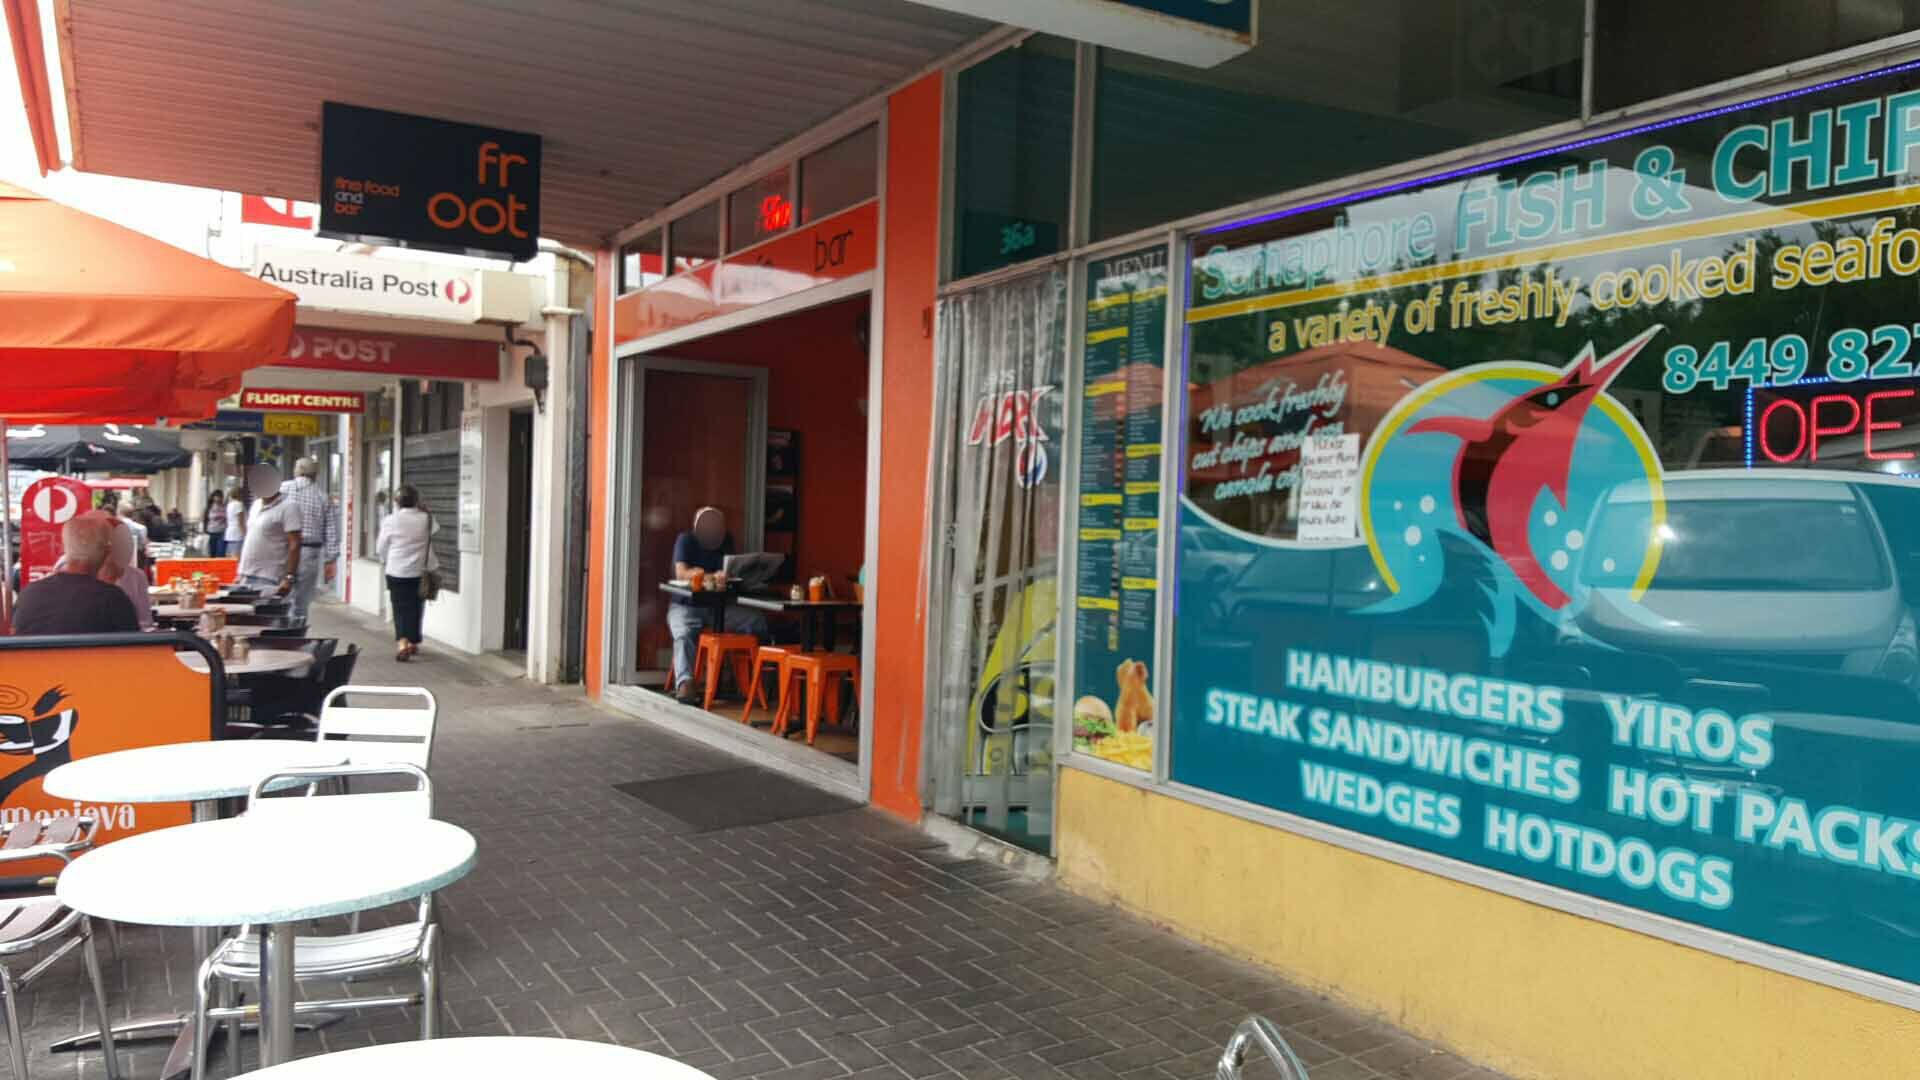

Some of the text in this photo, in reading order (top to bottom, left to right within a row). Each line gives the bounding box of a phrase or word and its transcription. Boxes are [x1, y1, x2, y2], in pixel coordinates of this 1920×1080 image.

[365, 179, 399, 198] food
[478, 141, 528, 188] fr
[1455, 159, 1608, 252] FISH
[1632, 145, 1693, 221] &
[1712, 89, 1920, 204] CHIP
[334, 191, 363, 204] and
[334, 201, 364, 216] bar
[426, 192, 528, 238] oot
[815, 230, 853, 272] bar
[259, 262, 439, 298] Australia Post
[1268, 216, 1920, 353] a variety of freshly cooked seafo
[312, 337, 394, 363] POST
[1662, 334, 1809, 394] 8449
[246, 392, 361, 408] FLIGHT CENTRE
[1235, 387, 1279, 425] cook
[1276, 369, 1347, 423] freshly
[1760, 389, 1915, 464] OPE
[1286, 648, 1565, 734] HAMBURGERS
[1205, 687, 1581, 805] STEAK SANDWICHES
[1602, 696, 1775, 769] YIROS
[1607, 763, 1725, 834] HOT
[1300, 758, 1734, 910] WEDGES HOTDOGS
